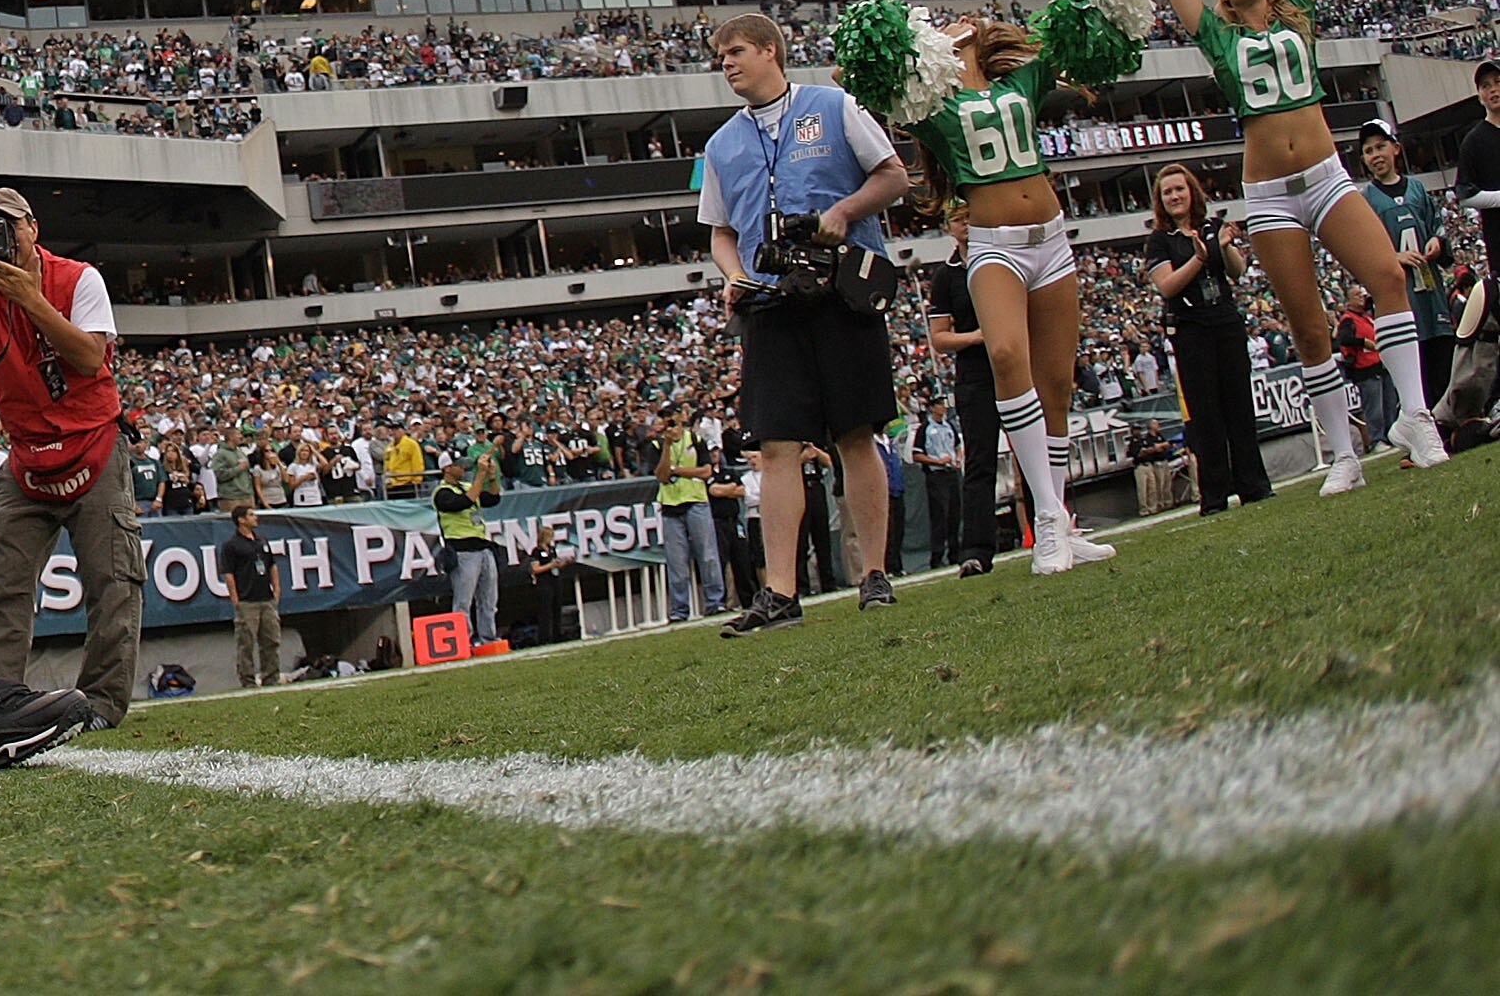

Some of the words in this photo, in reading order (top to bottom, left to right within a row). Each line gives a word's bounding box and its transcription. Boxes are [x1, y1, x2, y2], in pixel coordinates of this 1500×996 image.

[1236, 30, 1314, 109] 60
[798, 126, 821, 141] NFL
[958, 91, 1039, 177] 60
[1079, 121, 1204, 151] HERREMANS
[523, 449, 543, 465] 55
[24, 467, 91, 496] Canon
[425, 620, 457, 659] G
